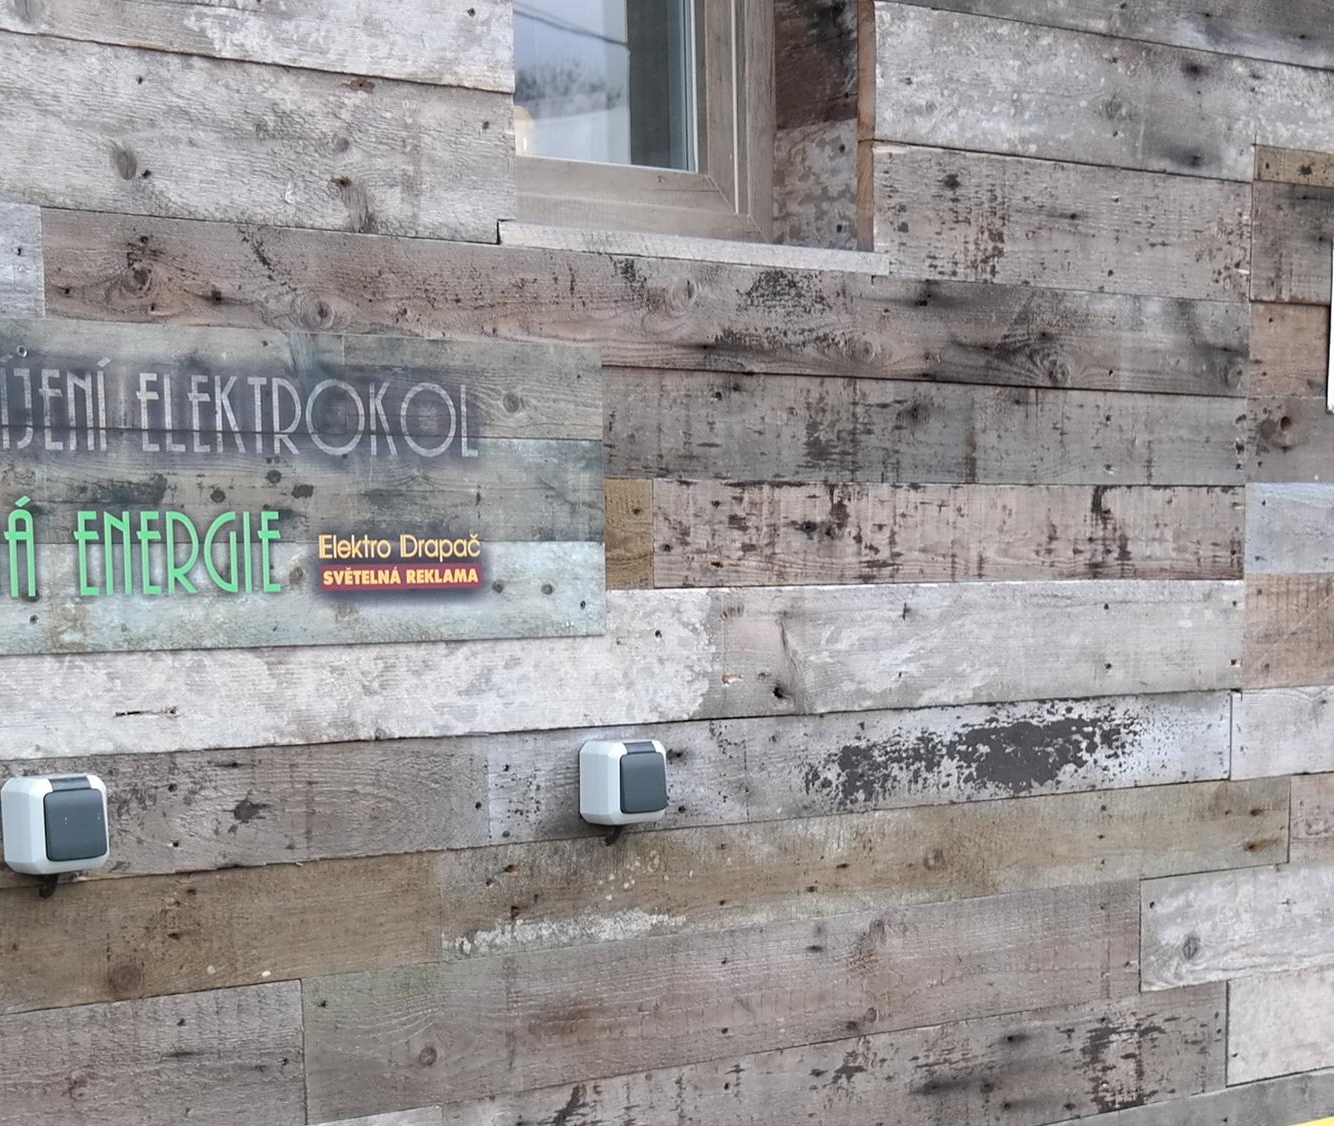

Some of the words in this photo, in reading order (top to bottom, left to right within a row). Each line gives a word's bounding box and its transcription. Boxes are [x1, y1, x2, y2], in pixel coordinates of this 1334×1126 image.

[136, 372, 479, 458] ELEKTROKOL
[73, 510, 282, 596] ENERGIE
[318, 534, 392, 560] Elektro
[399, 533, 481, 562] Drapač
[323, 566, 401, 586] SVĚTELNÁ
[406, 568, 479, 584] REKLAMA
